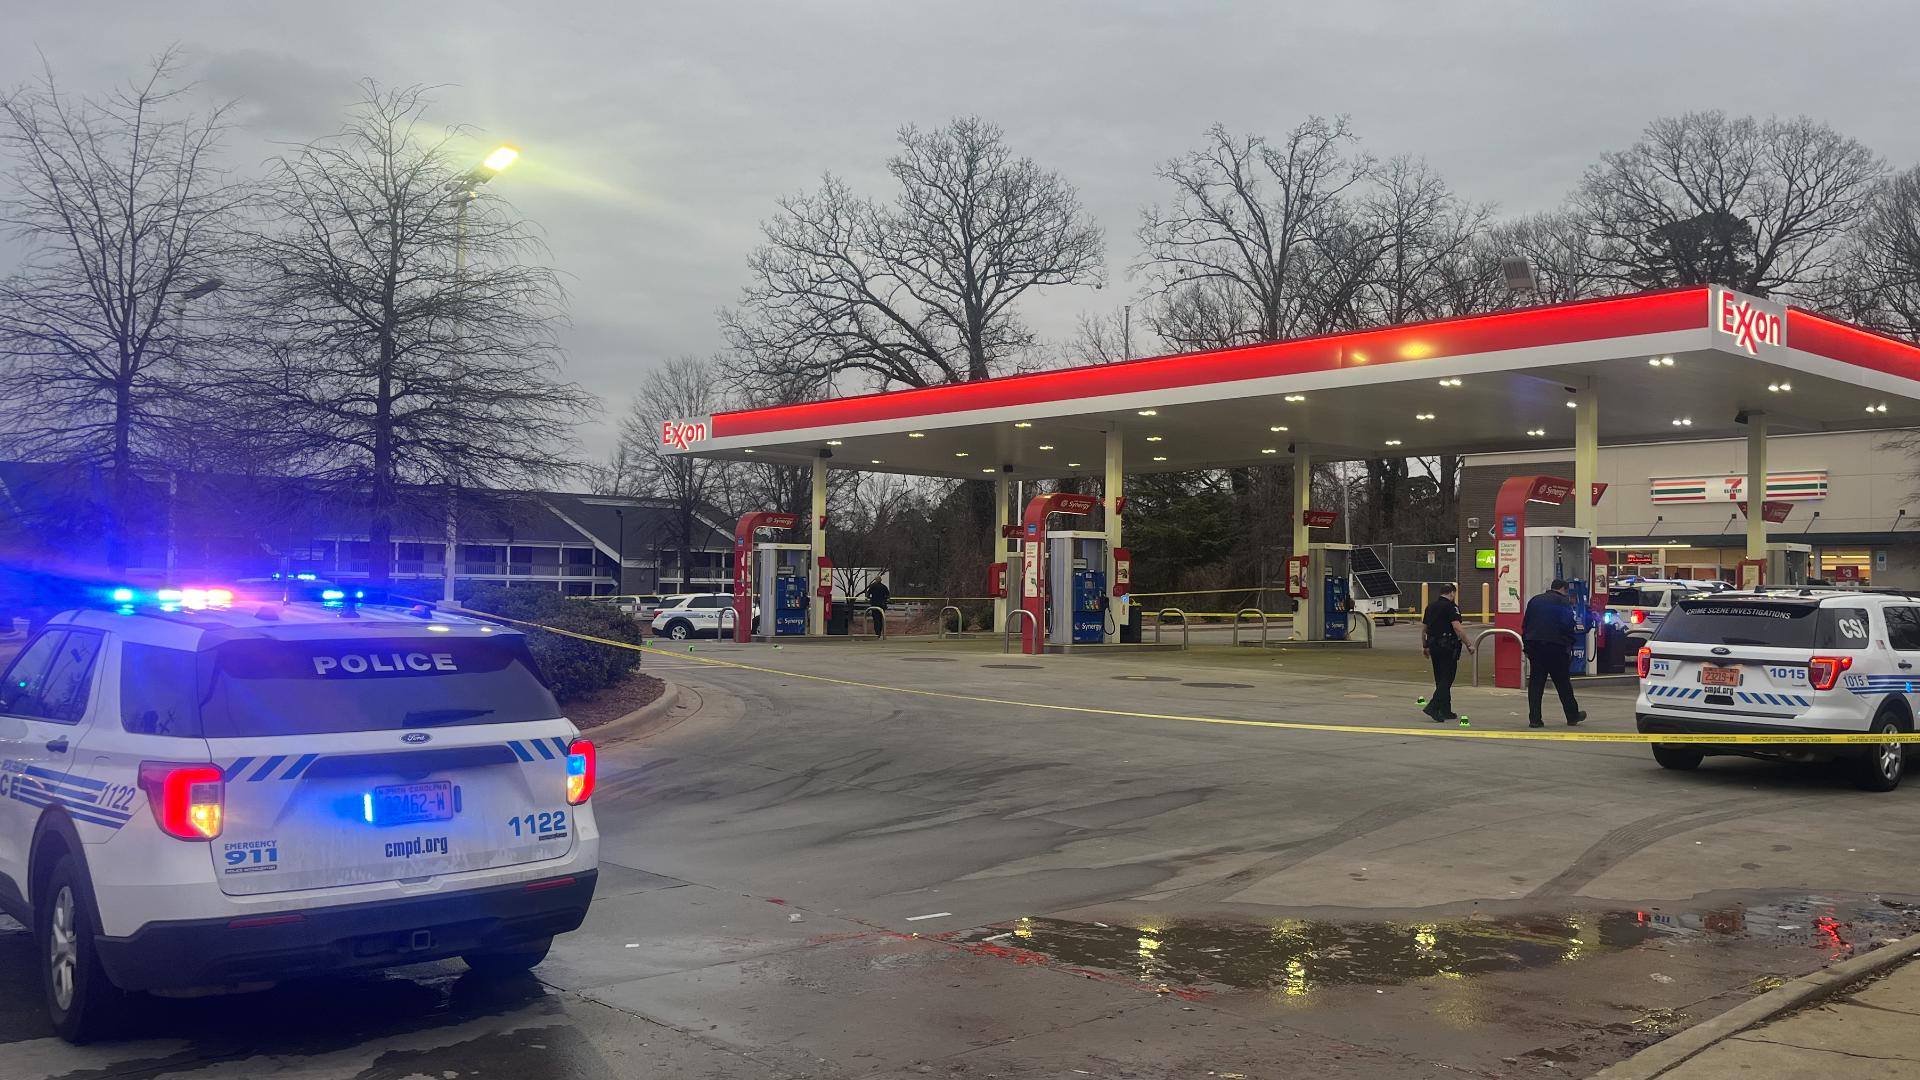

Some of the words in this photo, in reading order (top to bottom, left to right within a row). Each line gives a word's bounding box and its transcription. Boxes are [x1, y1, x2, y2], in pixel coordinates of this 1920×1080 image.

[1720, 290, 1782, 354] Exxon
[663, 422, 706, 450] Exxon
[1546, 486, 1567, 498] Synergy
[1725, 478, 1742, 500] 7
[1069, 501, 1090, 510] Synergy
[773, 517, 792, 525] Synergy
[1486, 555, 1495, 564] AT
[1686, 607, 1707, 615] CRIME
[1730, 607, 1791, 620] INVESTIGATIONS
[1081, 622, 1102, 632] Synergy
[1839, 618, 1867, 639] CSI
[312, 653, 458, 675] POLICE
[1654, 663, 1669, 671] 911
[1770, 667, 1806, 680] 1015
[1843, 675, 1864, 687] 1015
[1704, 686, 1734, 696] cmpd.org
[98, 781, 136, 811] 1122
[508, 810, 566, 837] 1122
[224, 839, 278, 851] EMERGENCY
[385, 836, 448, 858] cmpd.org
[225, 847, 278, 866] 911
